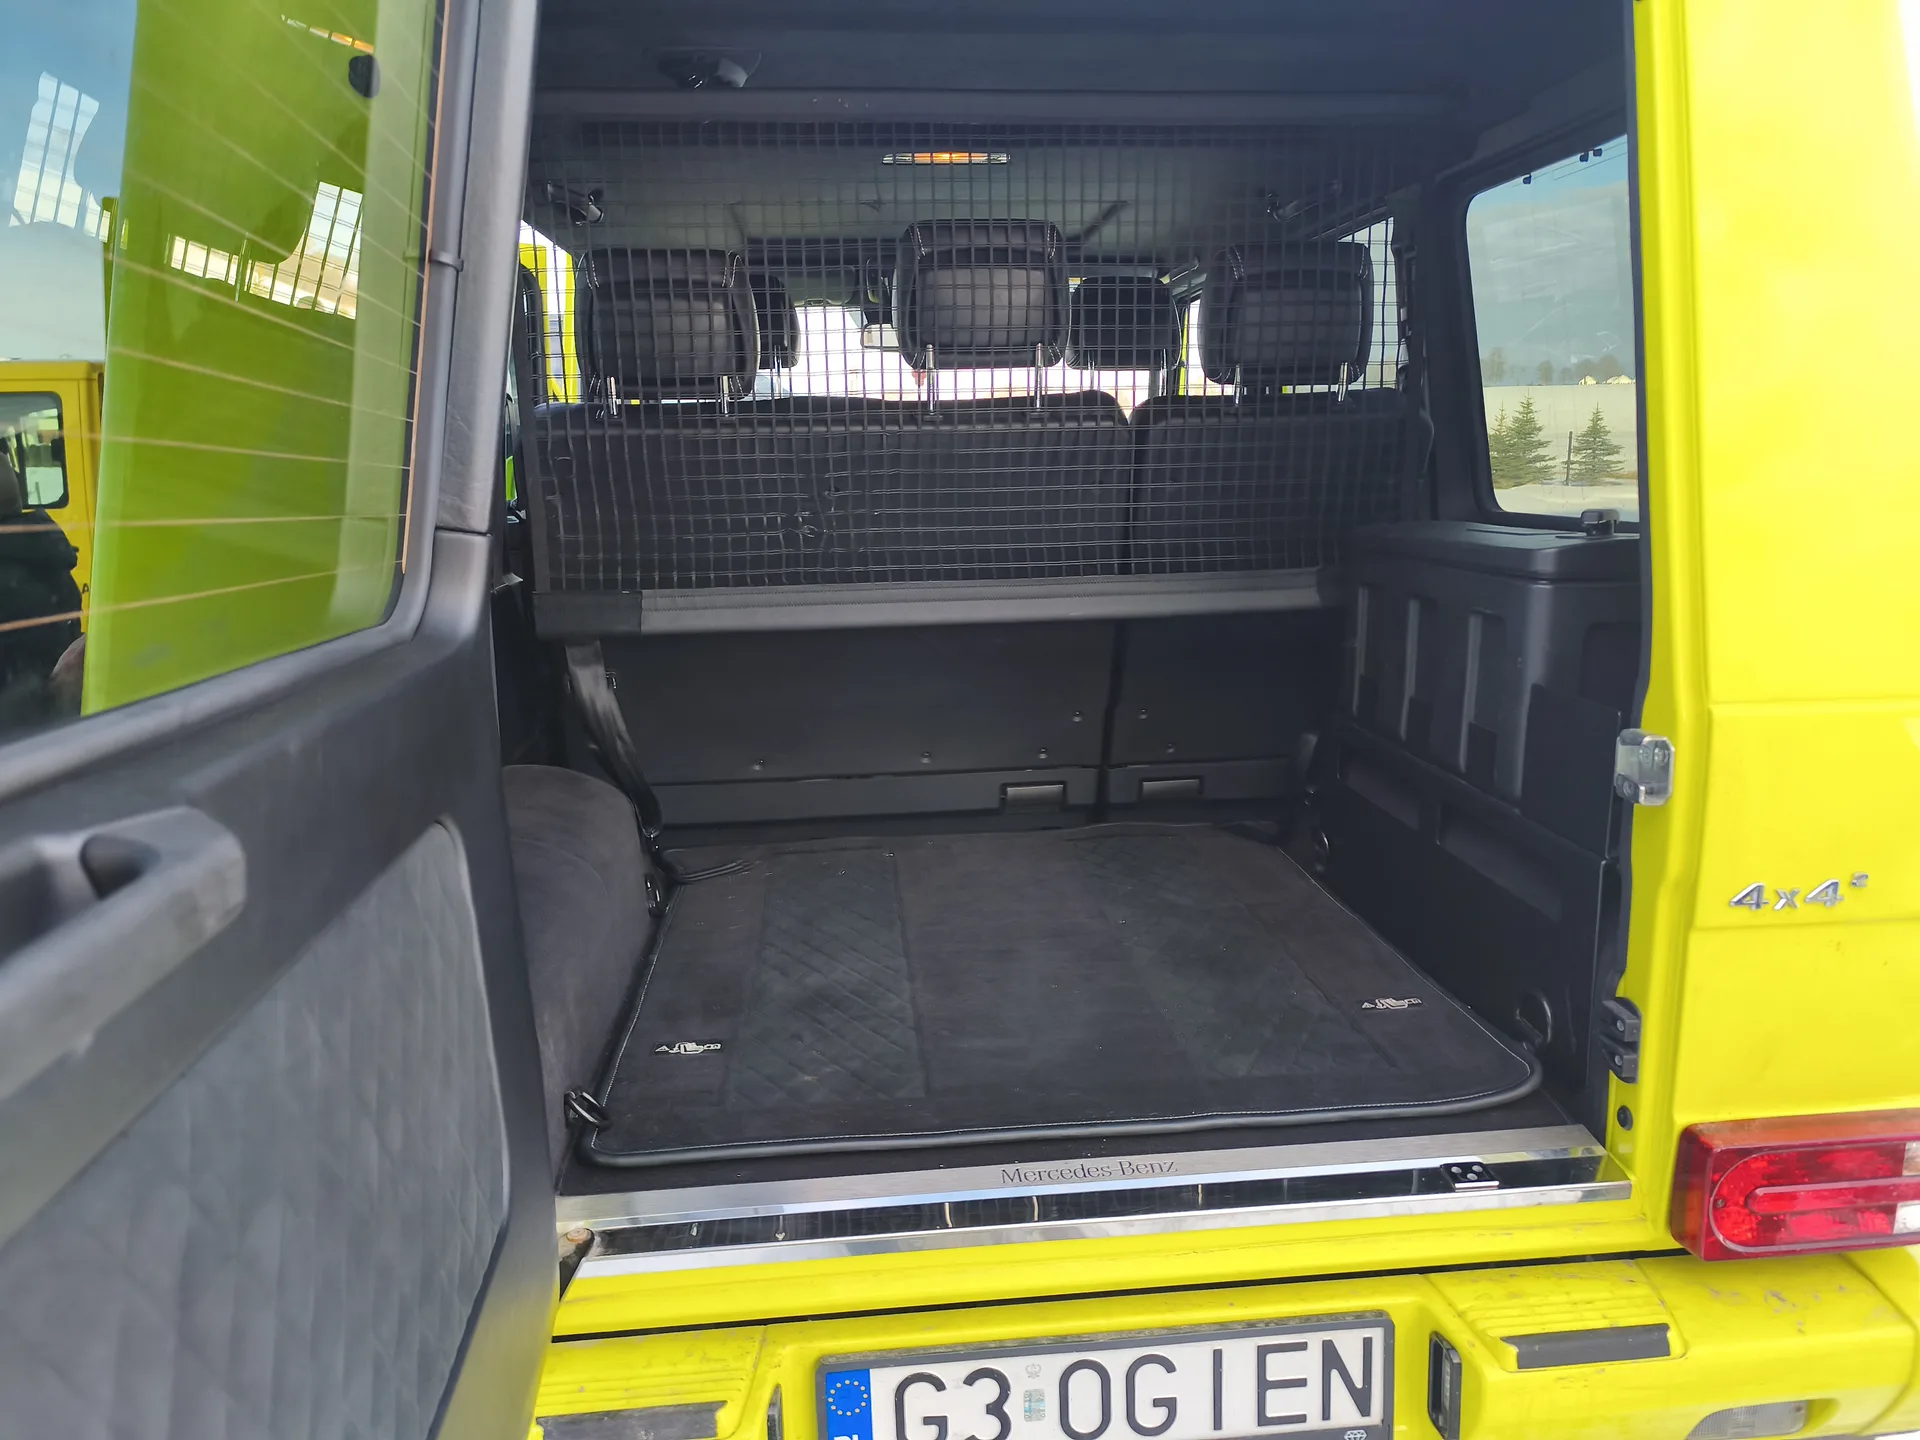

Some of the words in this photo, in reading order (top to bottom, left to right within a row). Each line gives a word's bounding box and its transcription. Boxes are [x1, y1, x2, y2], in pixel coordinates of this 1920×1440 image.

[1001, 1160, 1178, 1184] Mercedes-Benz
[894, 1367, 1012, 1440] G3
[1058, 1336, 1372, 1440] OGIEN
